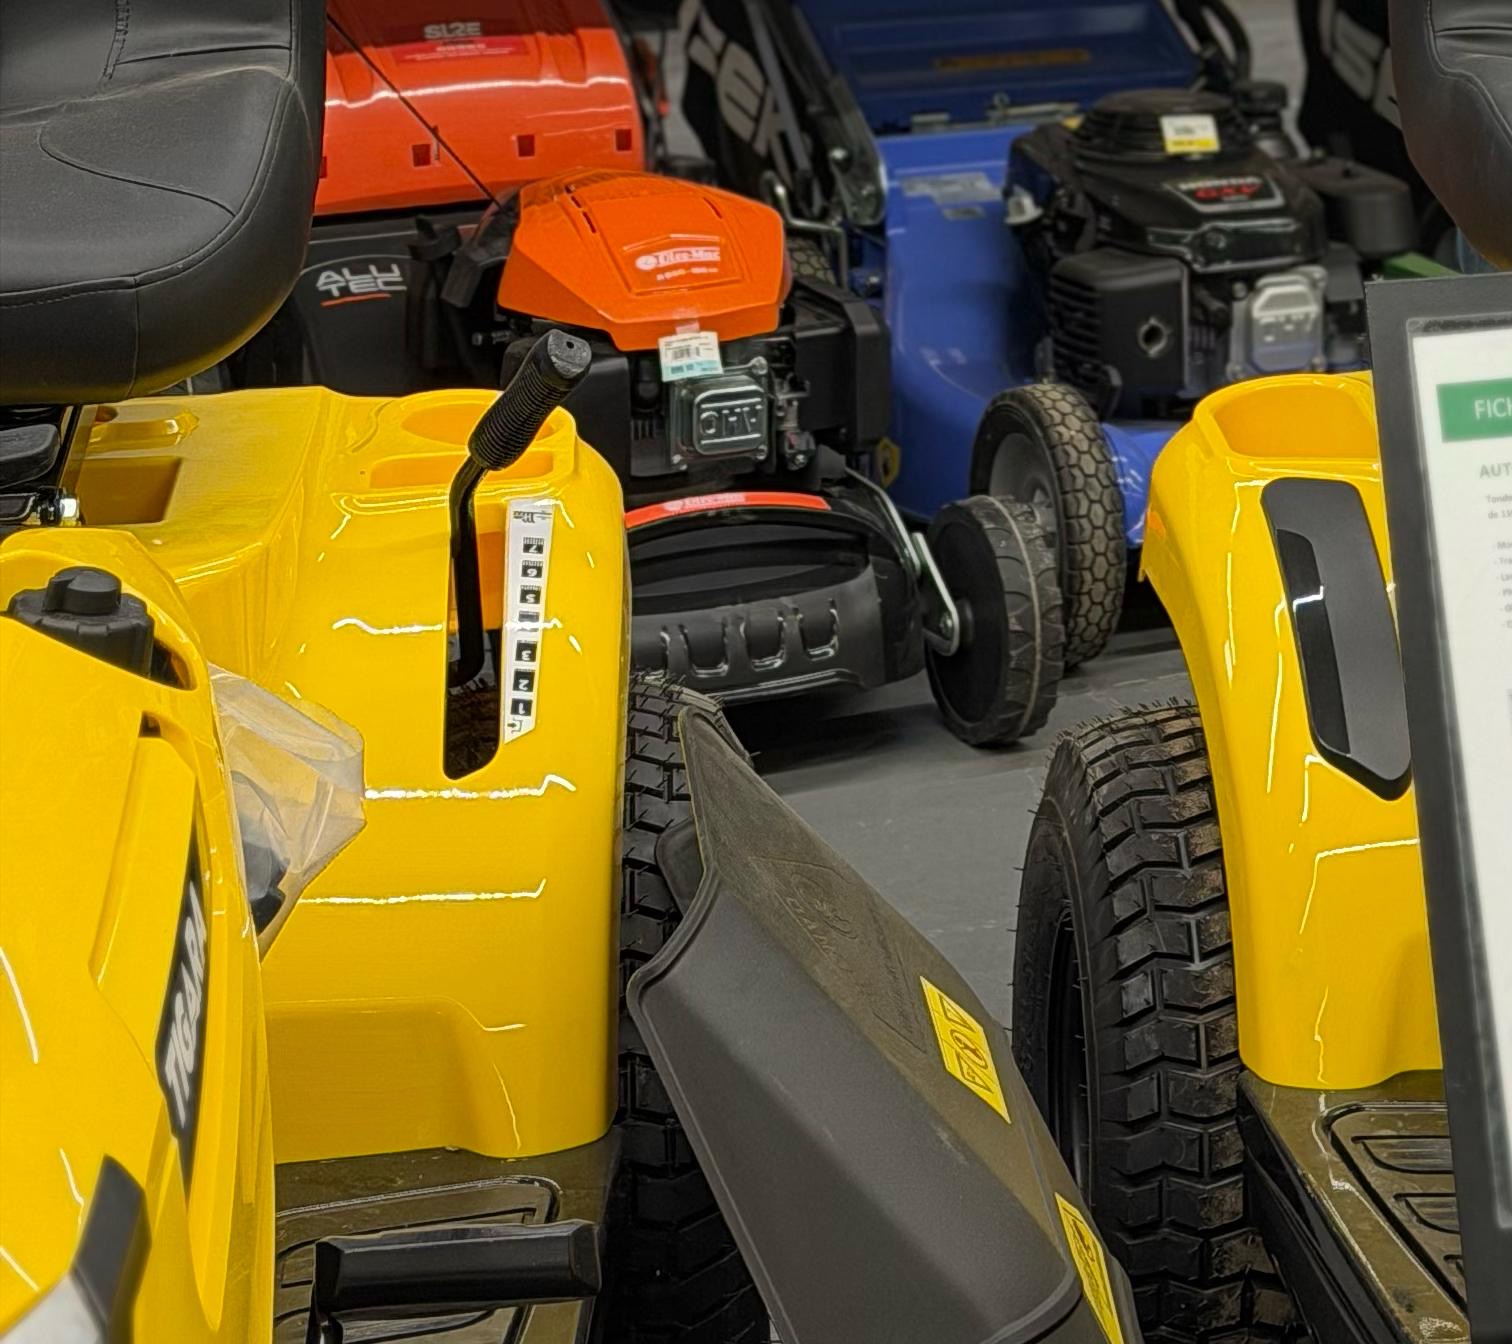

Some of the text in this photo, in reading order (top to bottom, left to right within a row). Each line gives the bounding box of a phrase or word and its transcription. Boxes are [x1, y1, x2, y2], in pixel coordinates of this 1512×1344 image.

[424, 22, 481, 39] SL2E
[316, 263, 402, 285] ALU
[321, 277, 407, 298] TEC
[165, 880, 208, 1128] TIGARA
